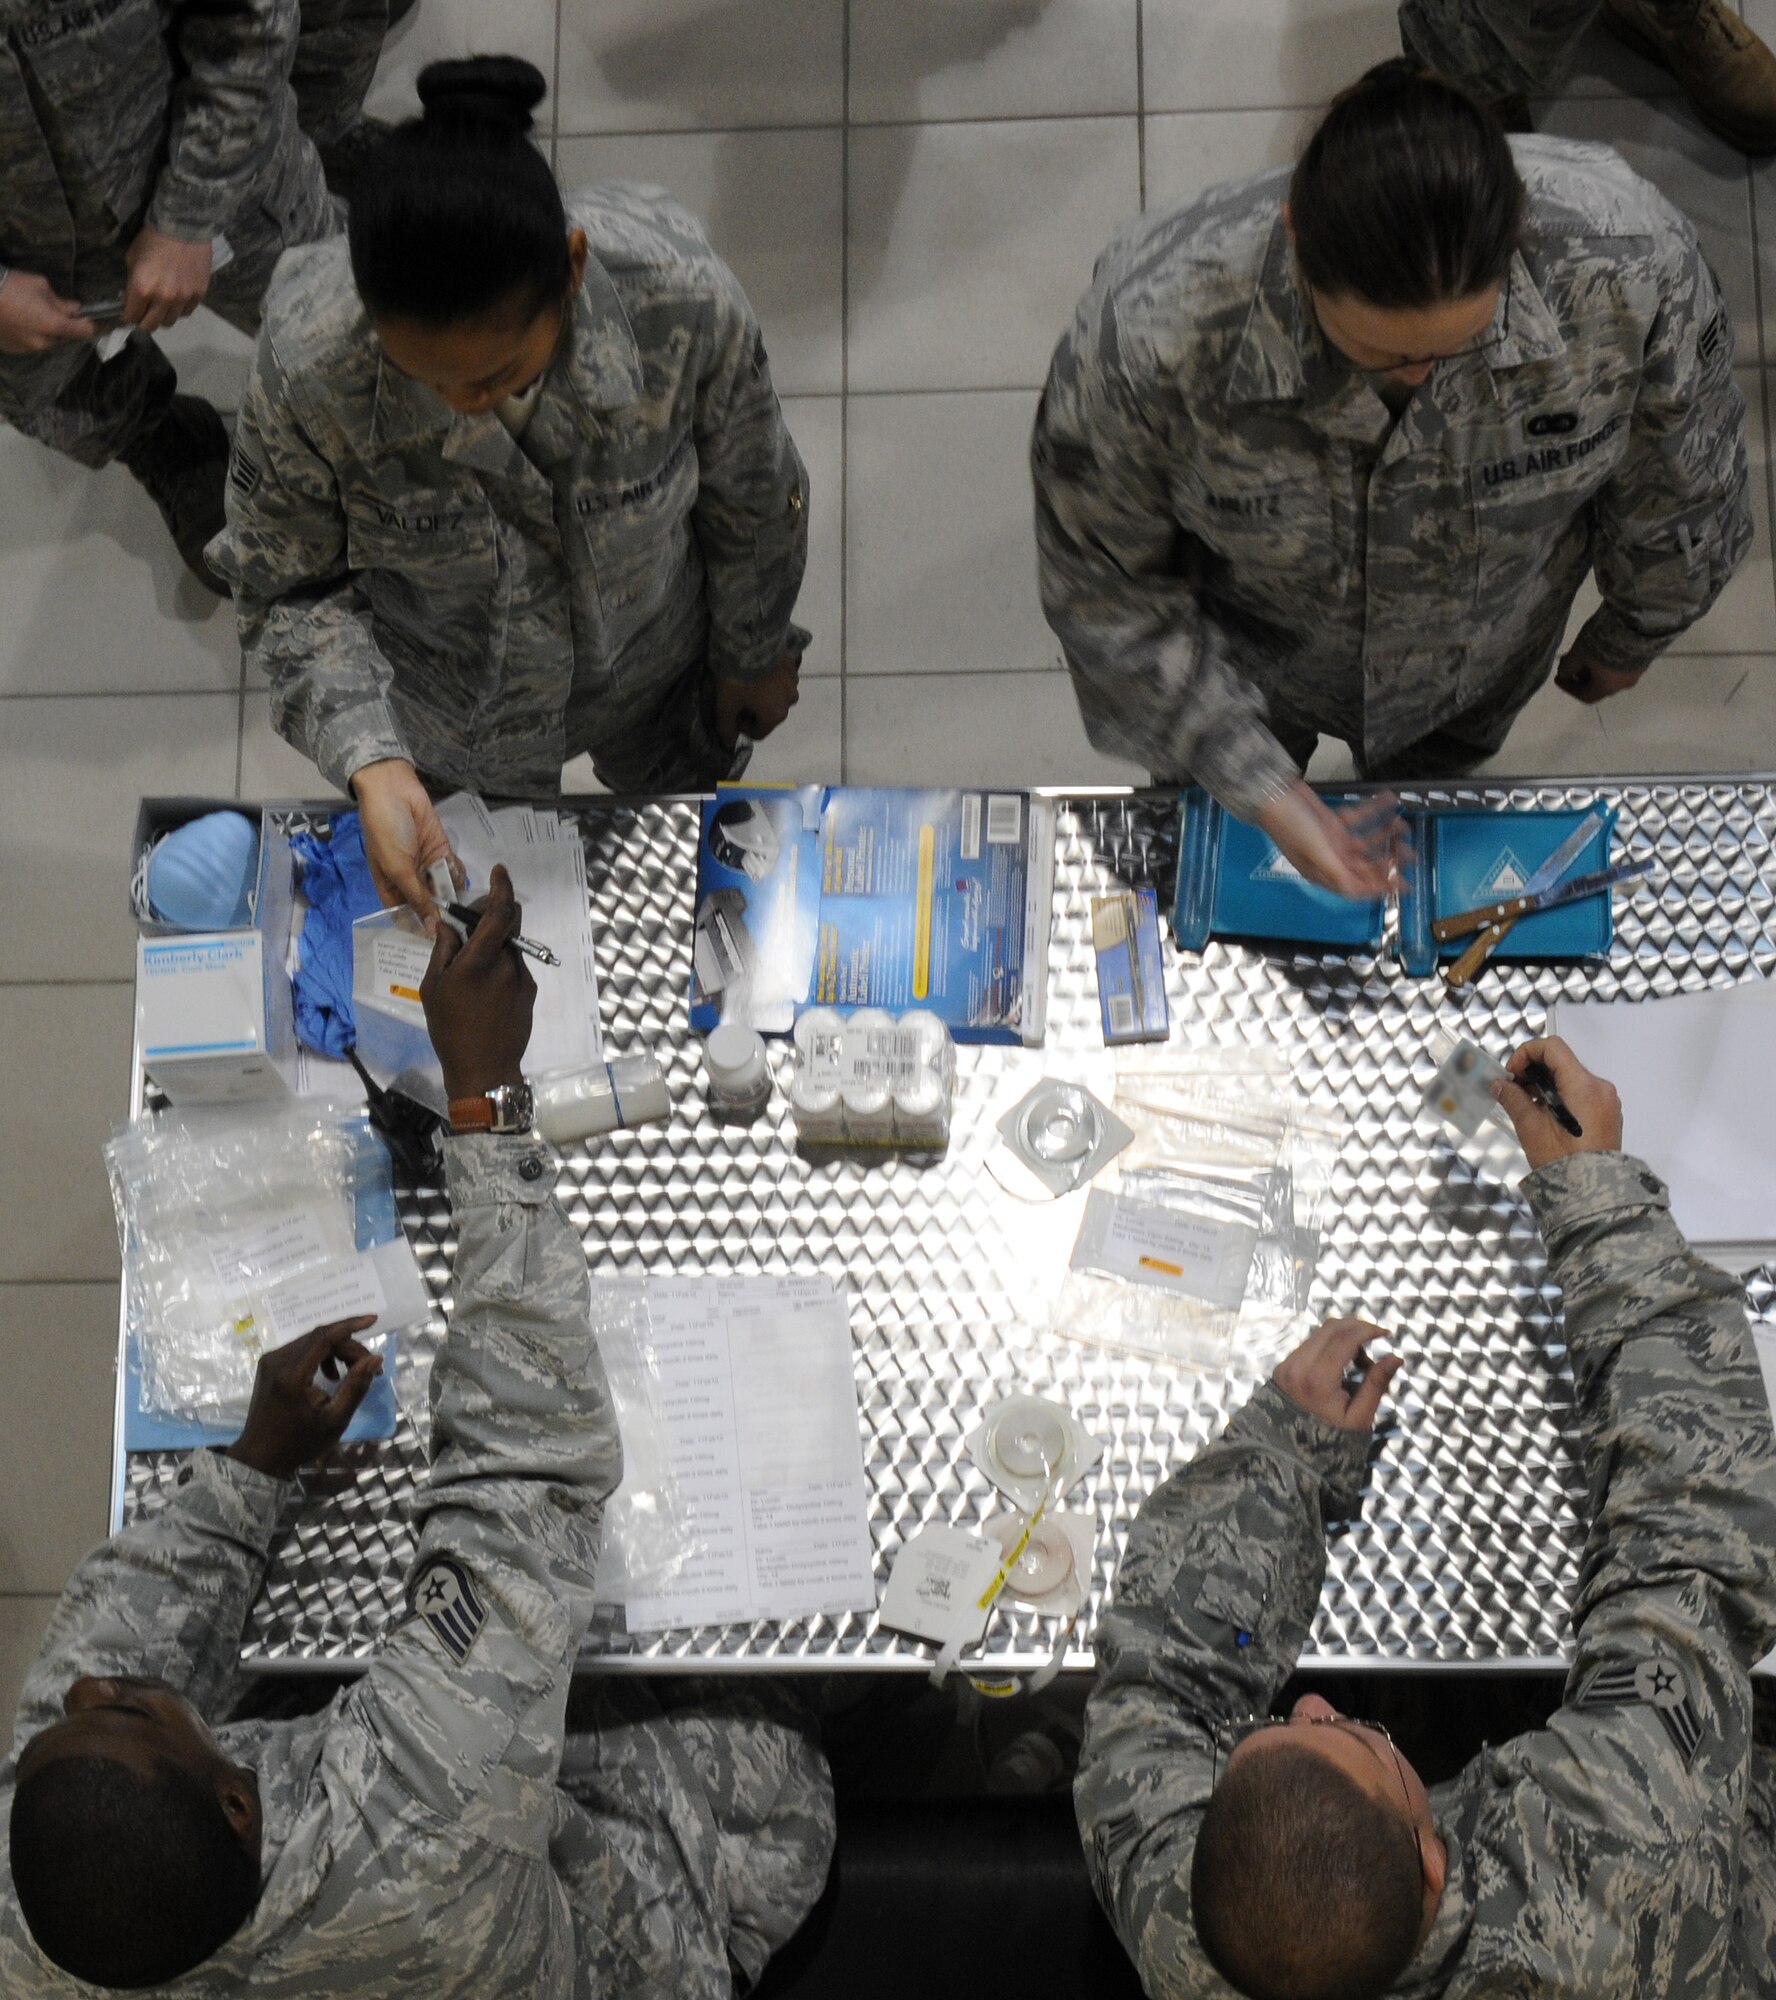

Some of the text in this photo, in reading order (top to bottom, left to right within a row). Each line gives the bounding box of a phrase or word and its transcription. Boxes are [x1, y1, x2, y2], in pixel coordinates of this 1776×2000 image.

[1483, 415, 1622, 485] U.S. AIR FORCE
